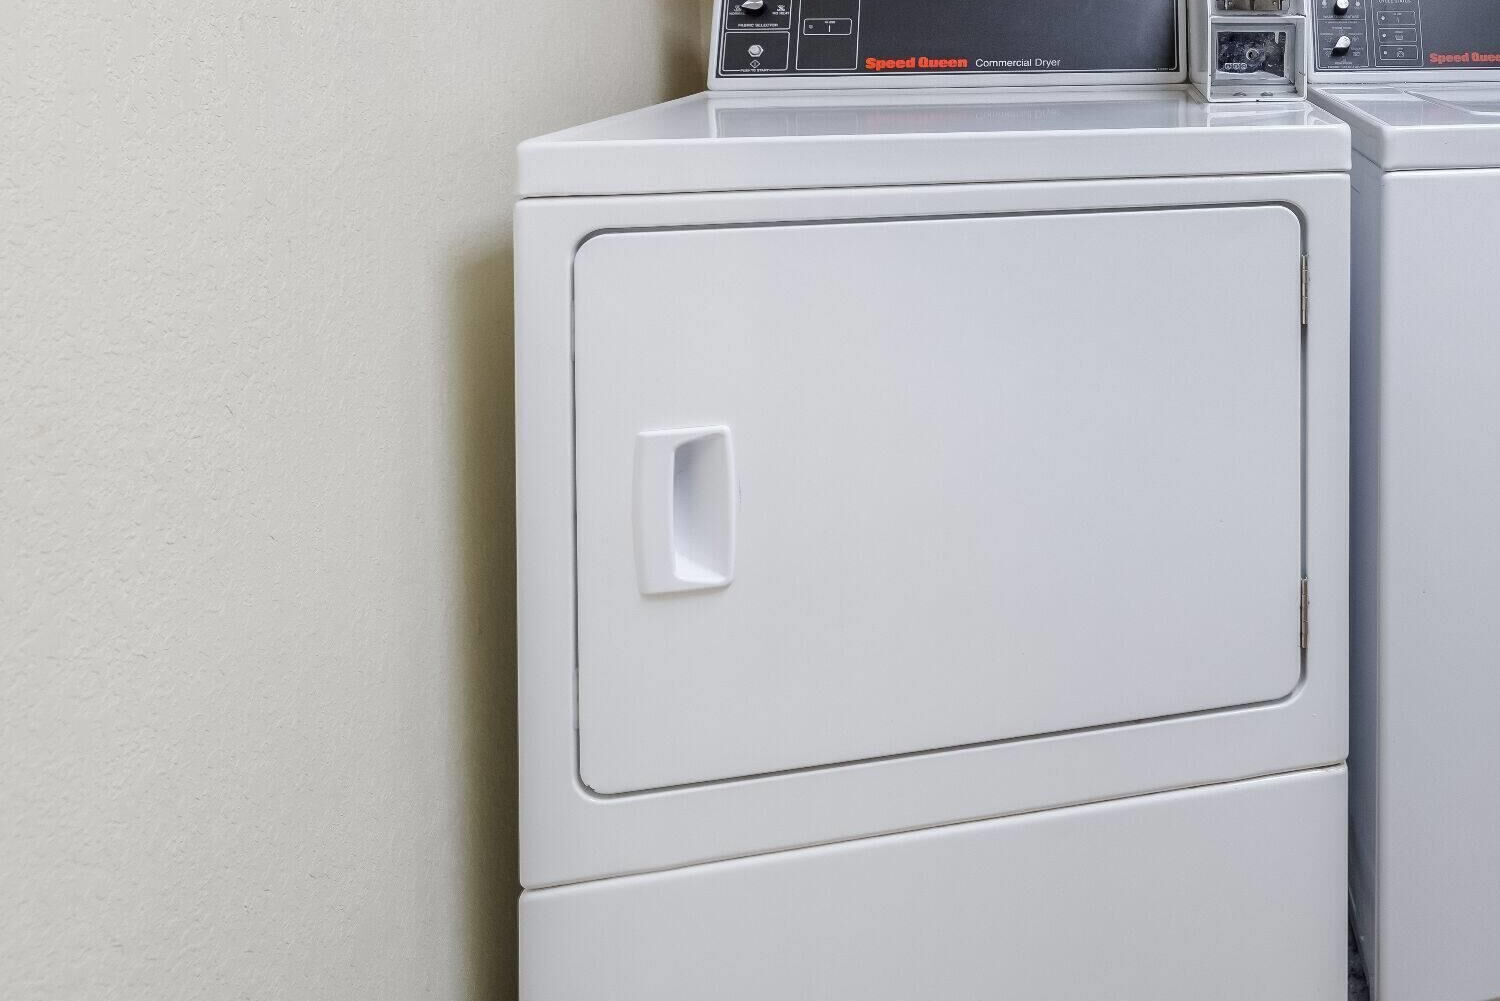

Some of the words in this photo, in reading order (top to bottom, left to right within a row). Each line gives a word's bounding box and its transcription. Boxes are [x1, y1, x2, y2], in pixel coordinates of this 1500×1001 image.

[865, 57, 916, 71] Speed
[918, 57, 968, 68] Queen
[975, 59, 1032, 68] Commercial
[1034, 58, 1061, 69] Dryer
[1429, 53, 1469, 64] Speed
